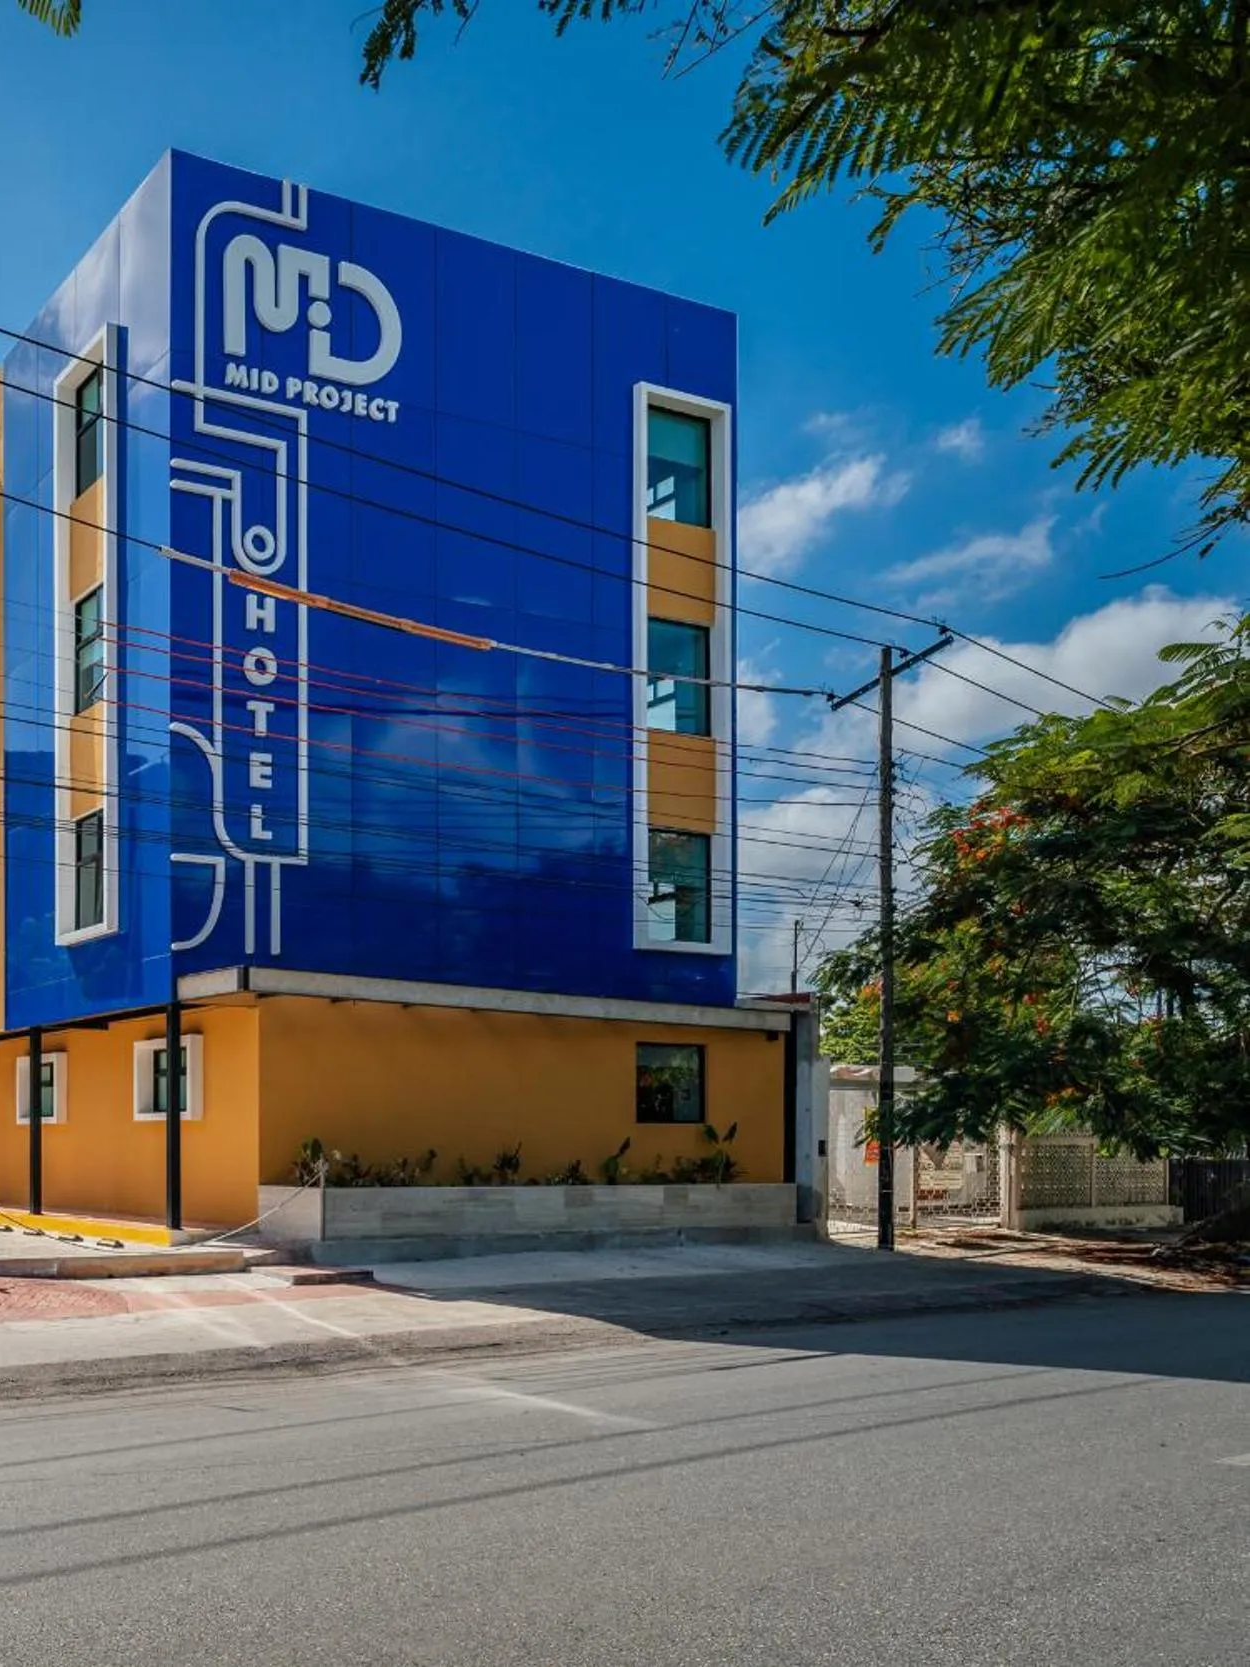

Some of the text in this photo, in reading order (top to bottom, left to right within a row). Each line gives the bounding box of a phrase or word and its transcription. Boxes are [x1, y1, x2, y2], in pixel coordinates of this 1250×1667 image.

[224, 362, 399, 423] MID PROJECT
[243, 594, 277, 840] HOTEL
